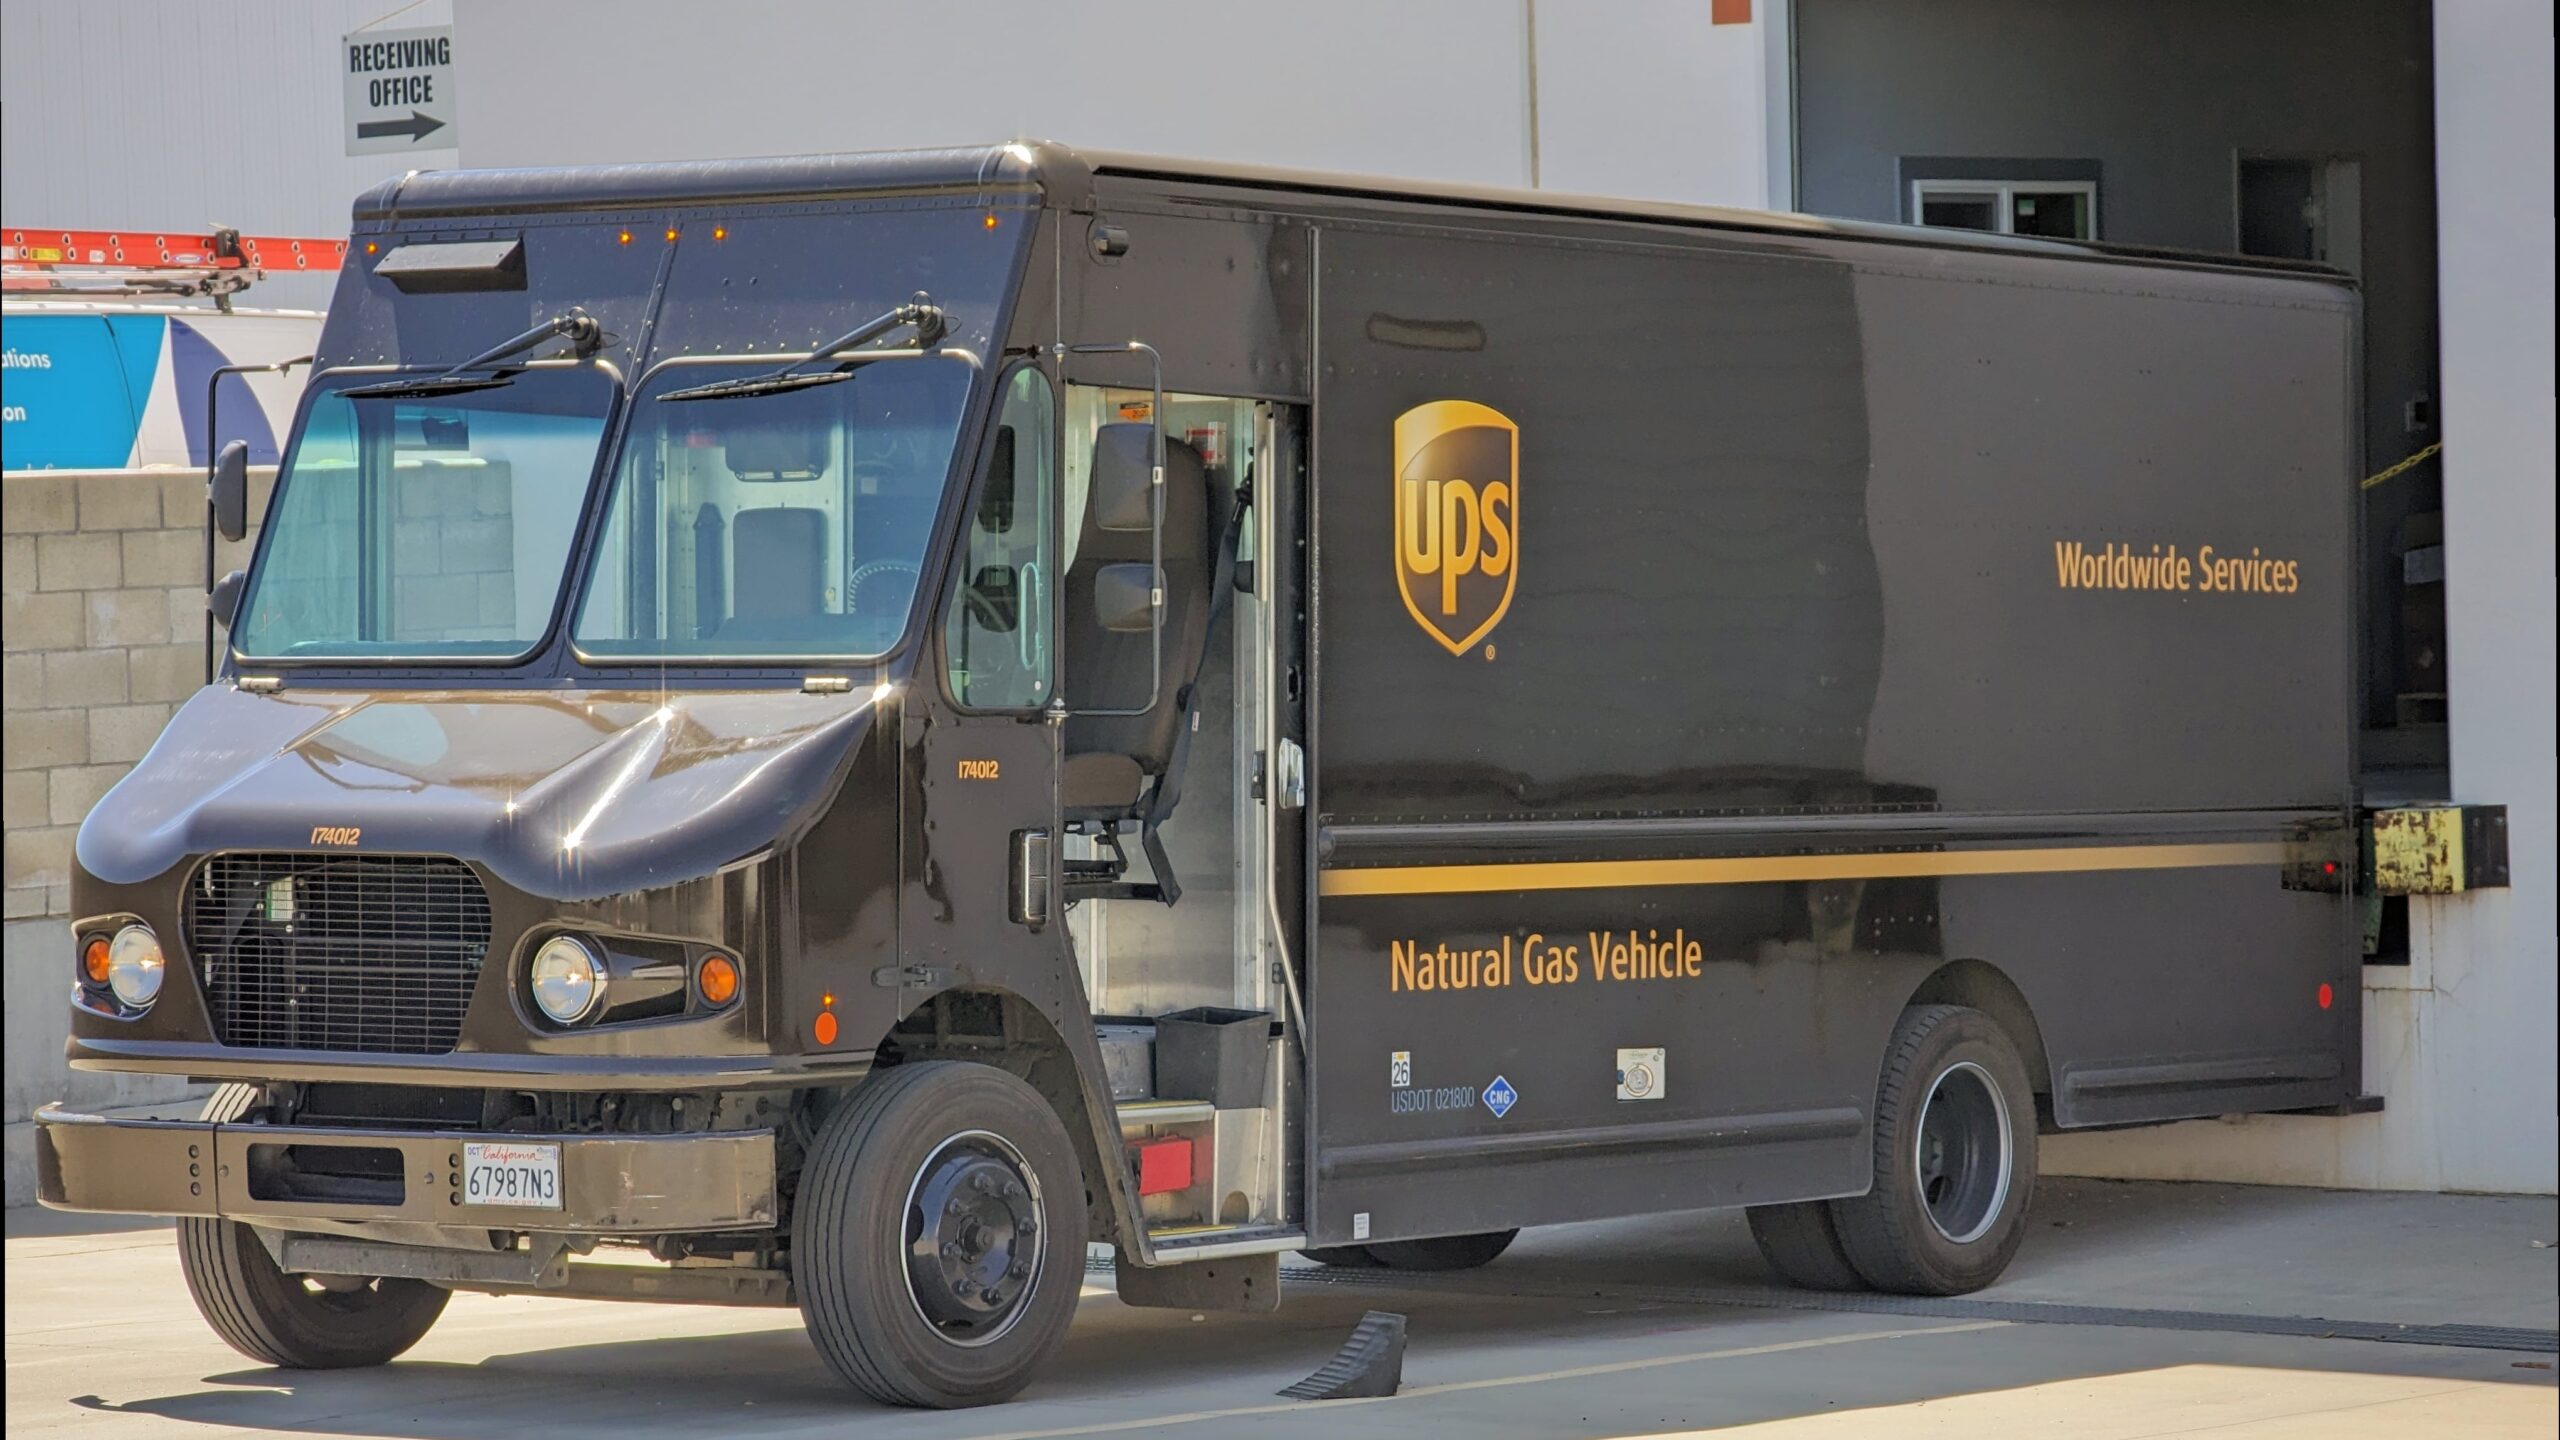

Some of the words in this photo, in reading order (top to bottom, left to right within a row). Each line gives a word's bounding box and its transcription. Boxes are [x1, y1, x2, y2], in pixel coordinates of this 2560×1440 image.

[350, 37, 450, 73] RECEIVING
[369, 75, 433, 107] OFFICE
[2056, 541, 2191, 590] Worldwide
[2200, 545, 2298, 593] Services
[959, 760, 998, 779] 174012
[311, 827, 361, 845] 174012
[1392, 935, 1511, 992] Natural
[1523, 934, 1578, 985] Gas
[1589, 928, 1702, 981] Vehicle
[1393, 1061, 1409, 1085] 26
[1392, 1089, 1432, 1113] USDOT
[1435, 1086, 1475, 1110] 021800
[1490, 1090, 1510, 1105] CNG
[483, 1144, 543, 1164] California
[469, 1166, 554, 1199] 67987N3
